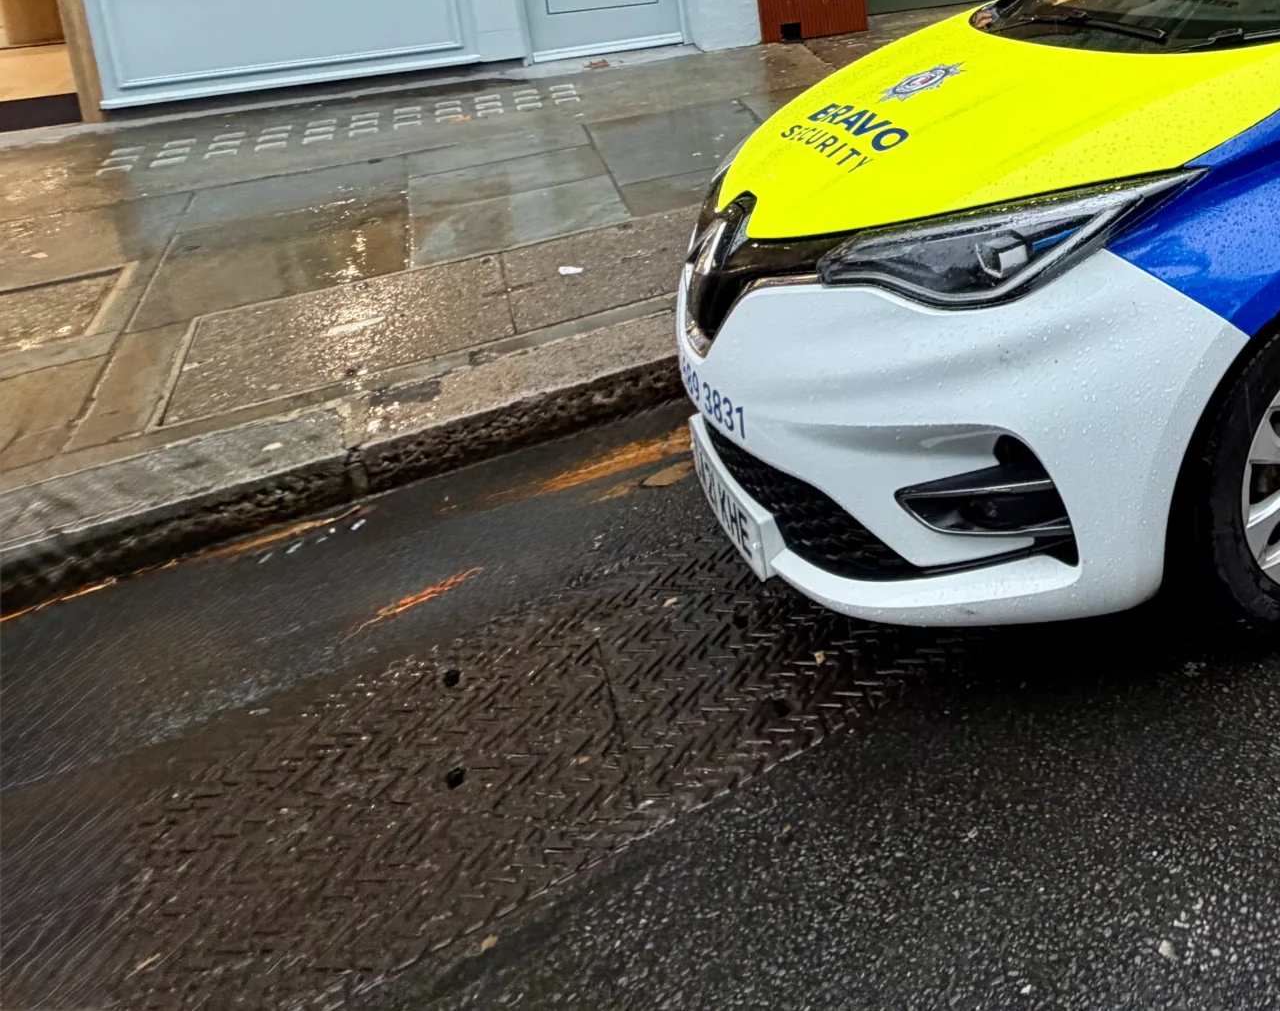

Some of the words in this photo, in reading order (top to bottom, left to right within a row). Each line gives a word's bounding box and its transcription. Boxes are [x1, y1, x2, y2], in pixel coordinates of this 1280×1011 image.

[781, 124, 874, 173] SECURITY
[807, 103, 909, 151] BRAVO
[703, 381, 745, 439] 3831
